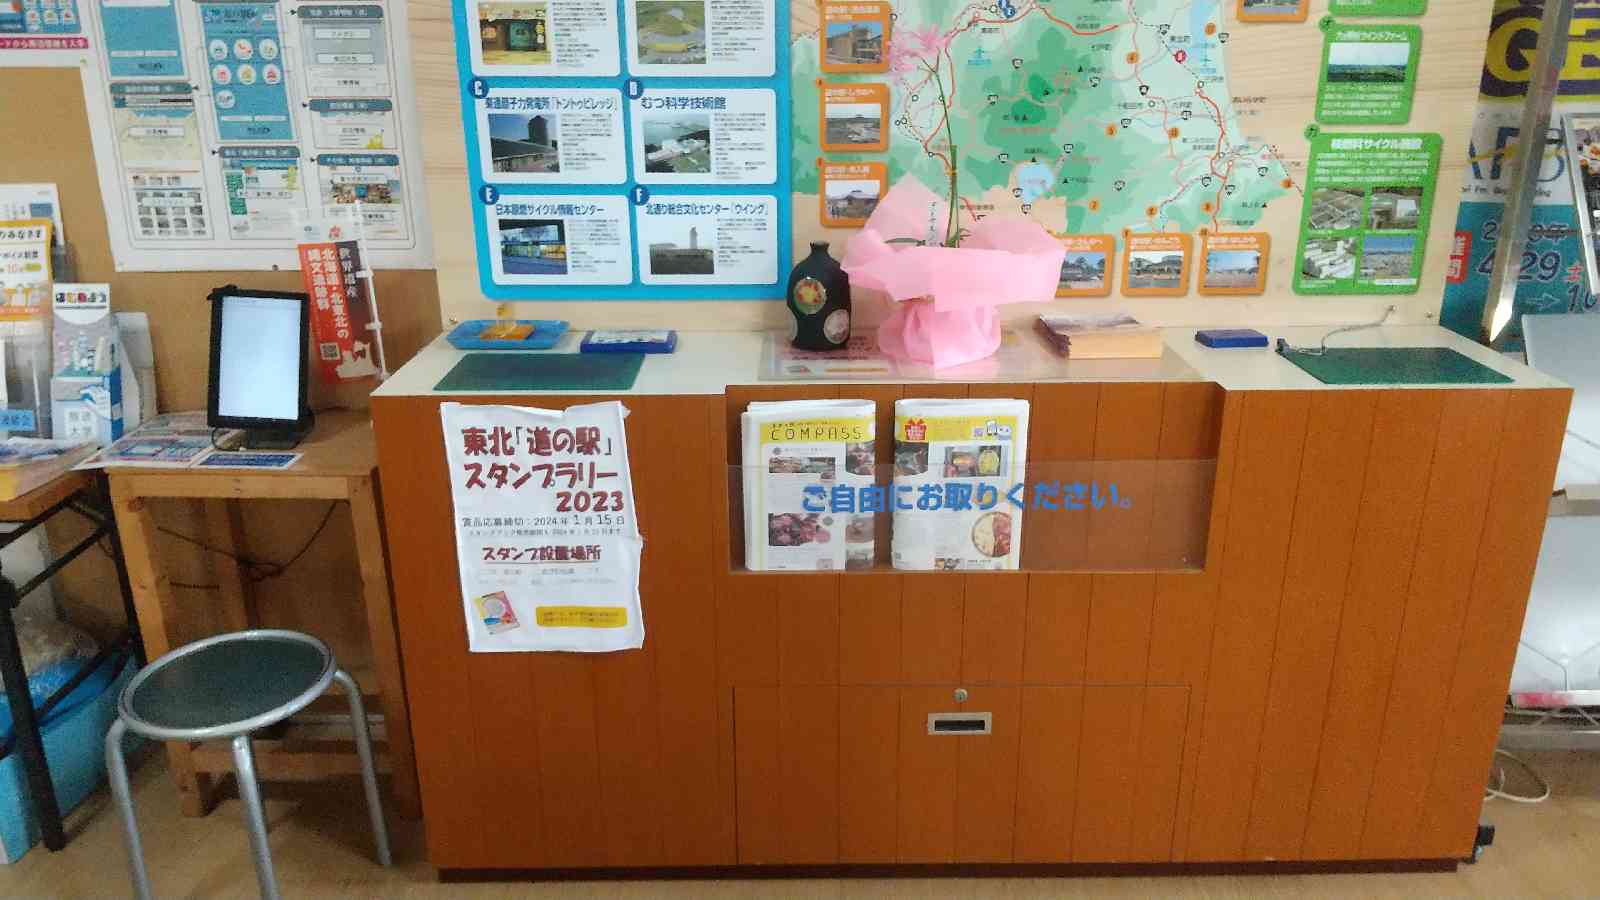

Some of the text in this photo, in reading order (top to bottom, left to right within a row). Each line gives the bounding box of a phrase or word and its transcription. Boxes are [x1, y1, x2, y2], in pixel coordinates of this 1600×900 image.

[641, 97, 727, 110] むつ科学技術館
[461, 426, 613, 456] 東北「道の駅」
[771, 428, 863, 441] COMPASS
[463, 461, 618, 489] スタンプラリー
[556, 490, 625, 513] 2023
[801, 479, 1133, 514] ご自由にお取りください。
[482, 544, 601, 561] スタンプ設置場所
